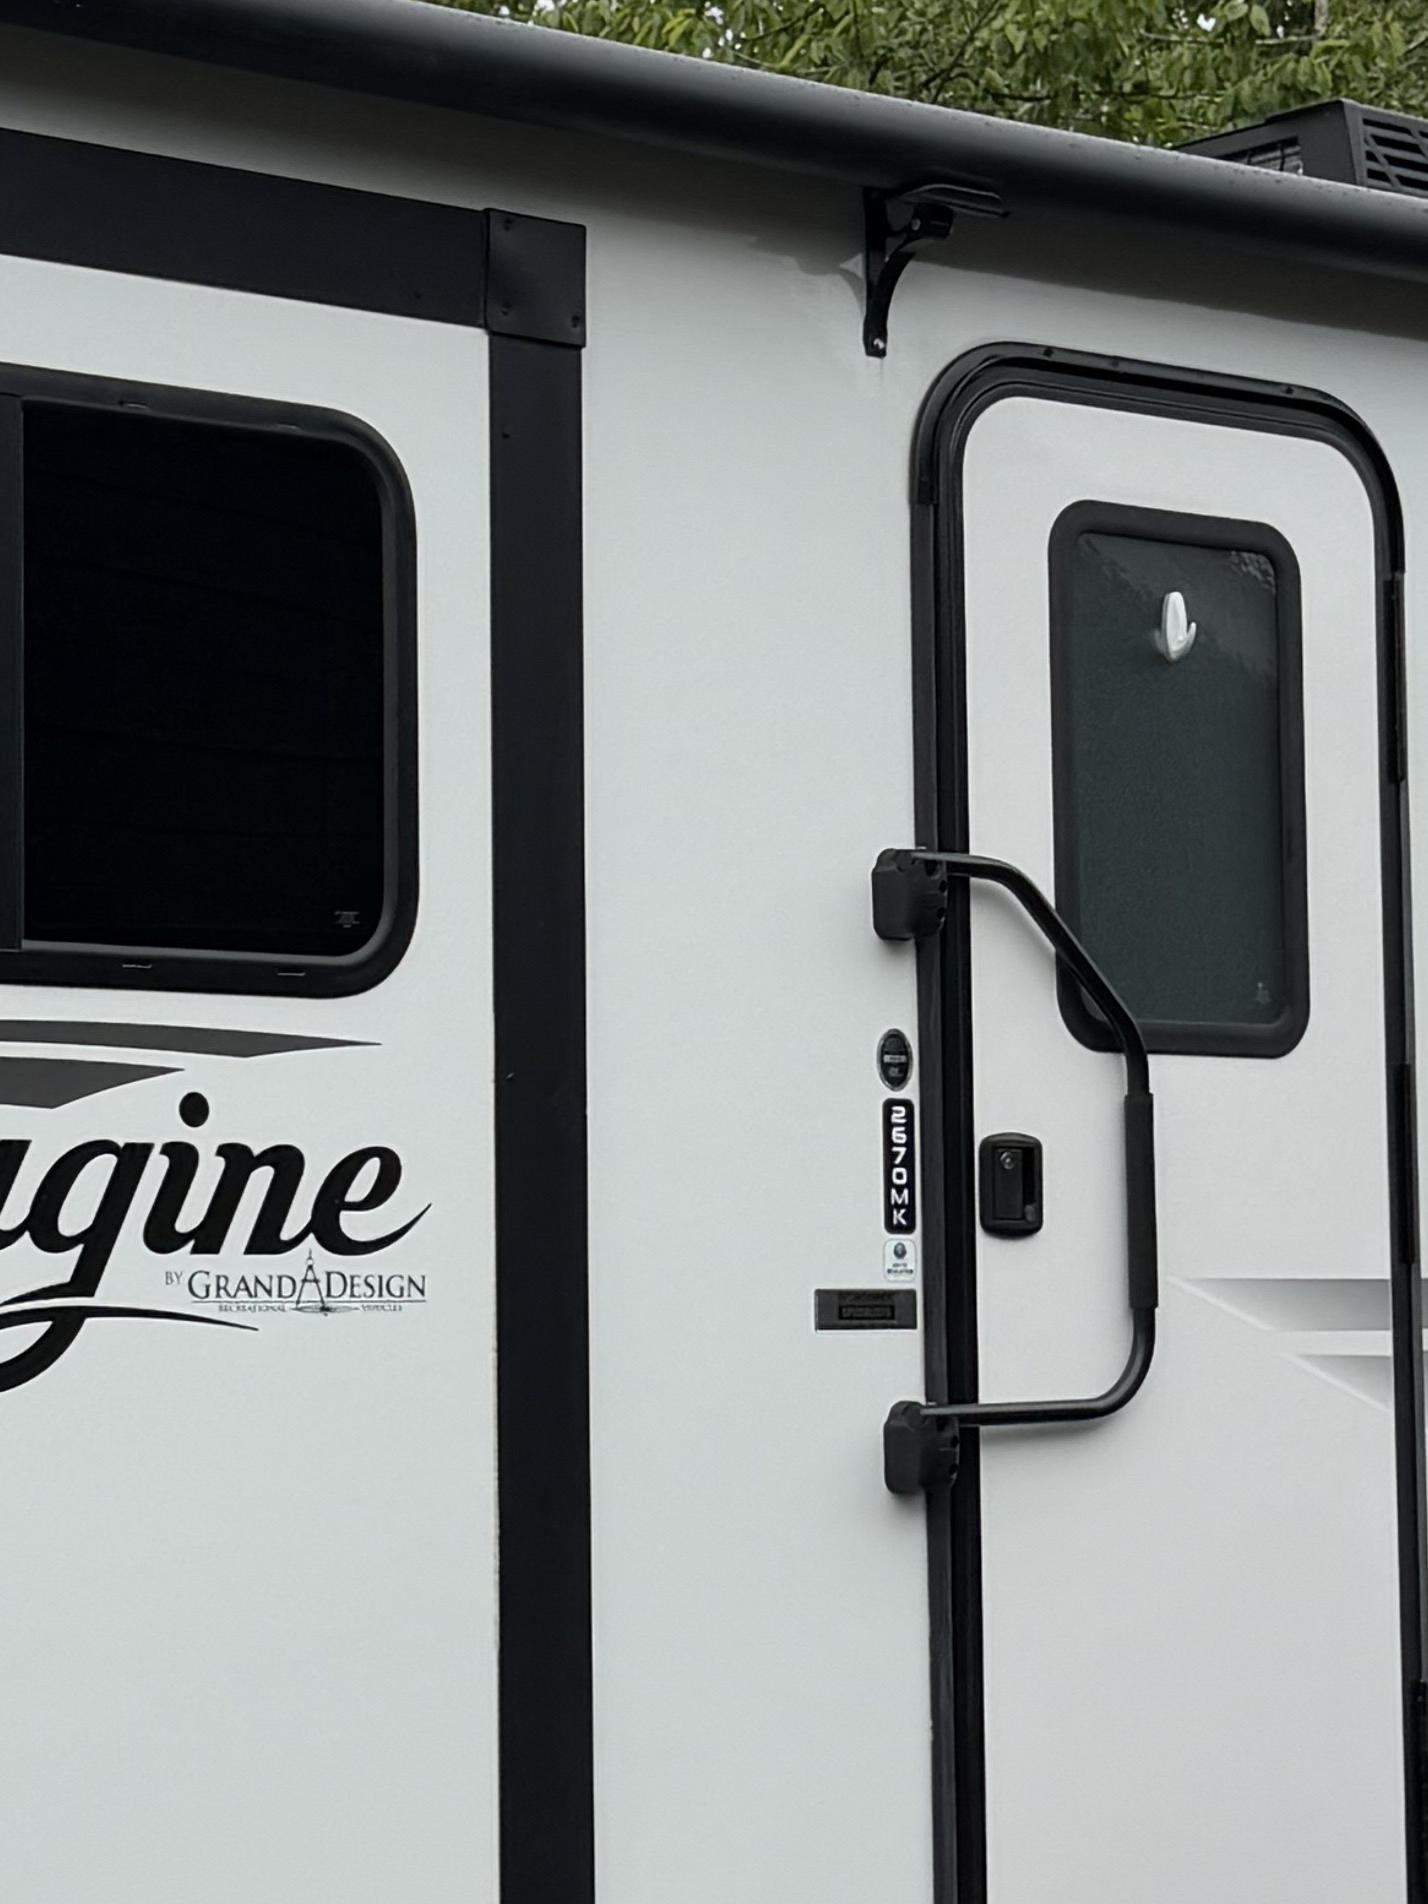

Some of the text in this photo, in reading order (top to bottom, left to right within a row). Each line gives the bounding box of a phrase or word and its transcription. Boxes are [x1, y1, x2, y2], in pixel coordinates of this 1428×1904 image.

[890, 1105, 909, 1226] 2670MK
[165, 1269, 426, 1300] BY GRAND DESIGN
